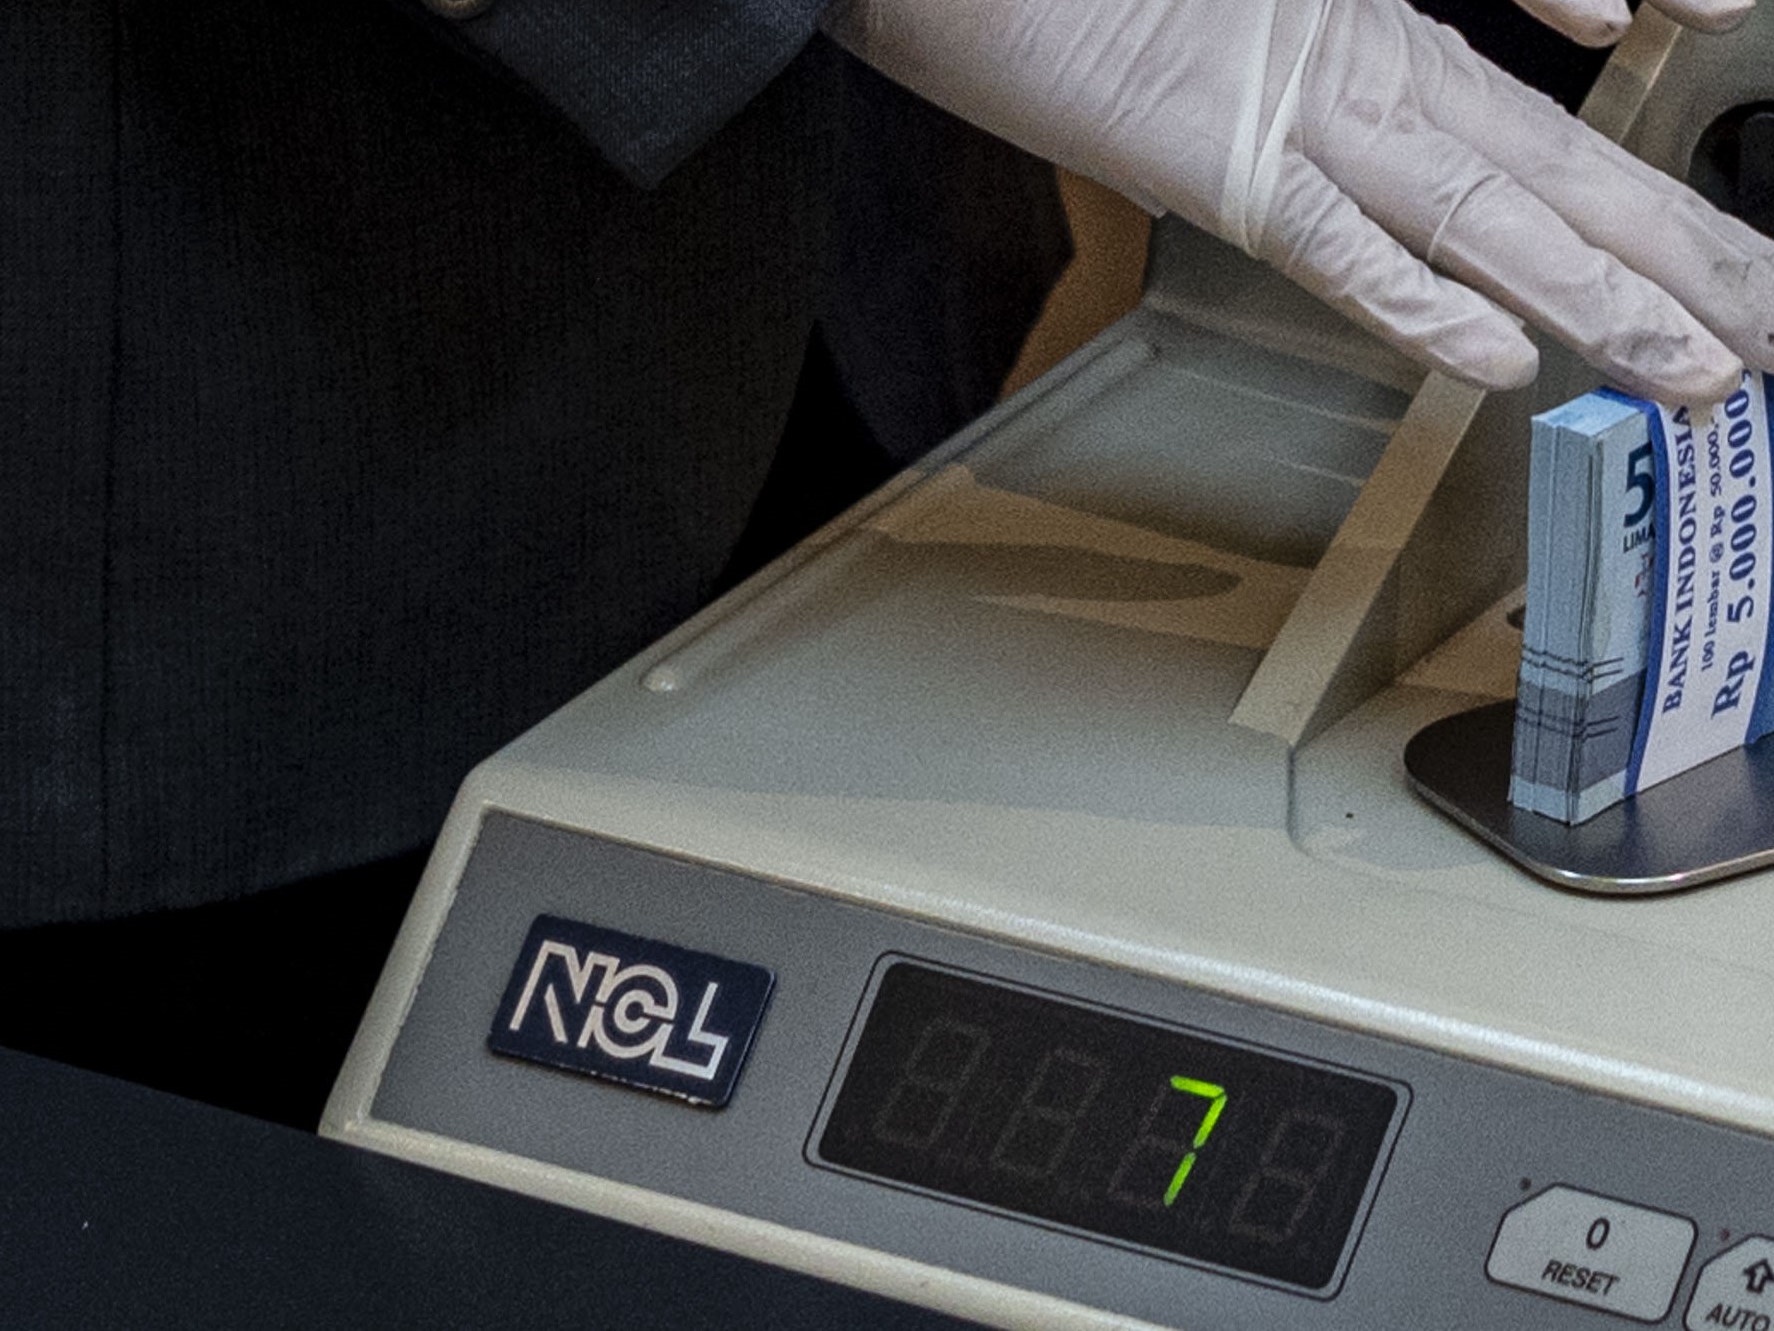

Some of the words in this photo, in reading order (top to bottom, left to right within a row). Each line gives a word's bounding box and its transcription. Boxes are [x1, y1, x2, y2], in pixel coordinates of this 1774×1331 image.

[1673, 405, 1698, 616] INDONESIA
[1710, 505, 1726, 539] Rp
[1705, 570, 1721, 645] lembar
[1663, 616, 1693, 714] BANK
[1701, 645, 1715, 672] 100
[1712, 648, 1756, 720] Rp
[1163, 1075, 1228, 1208] 7
[1585, 1216, 1612, 1251] 0
[1541, 1259, 1622, 1298] RESET
[1705, 1302, 1772, 1331] AUTO
